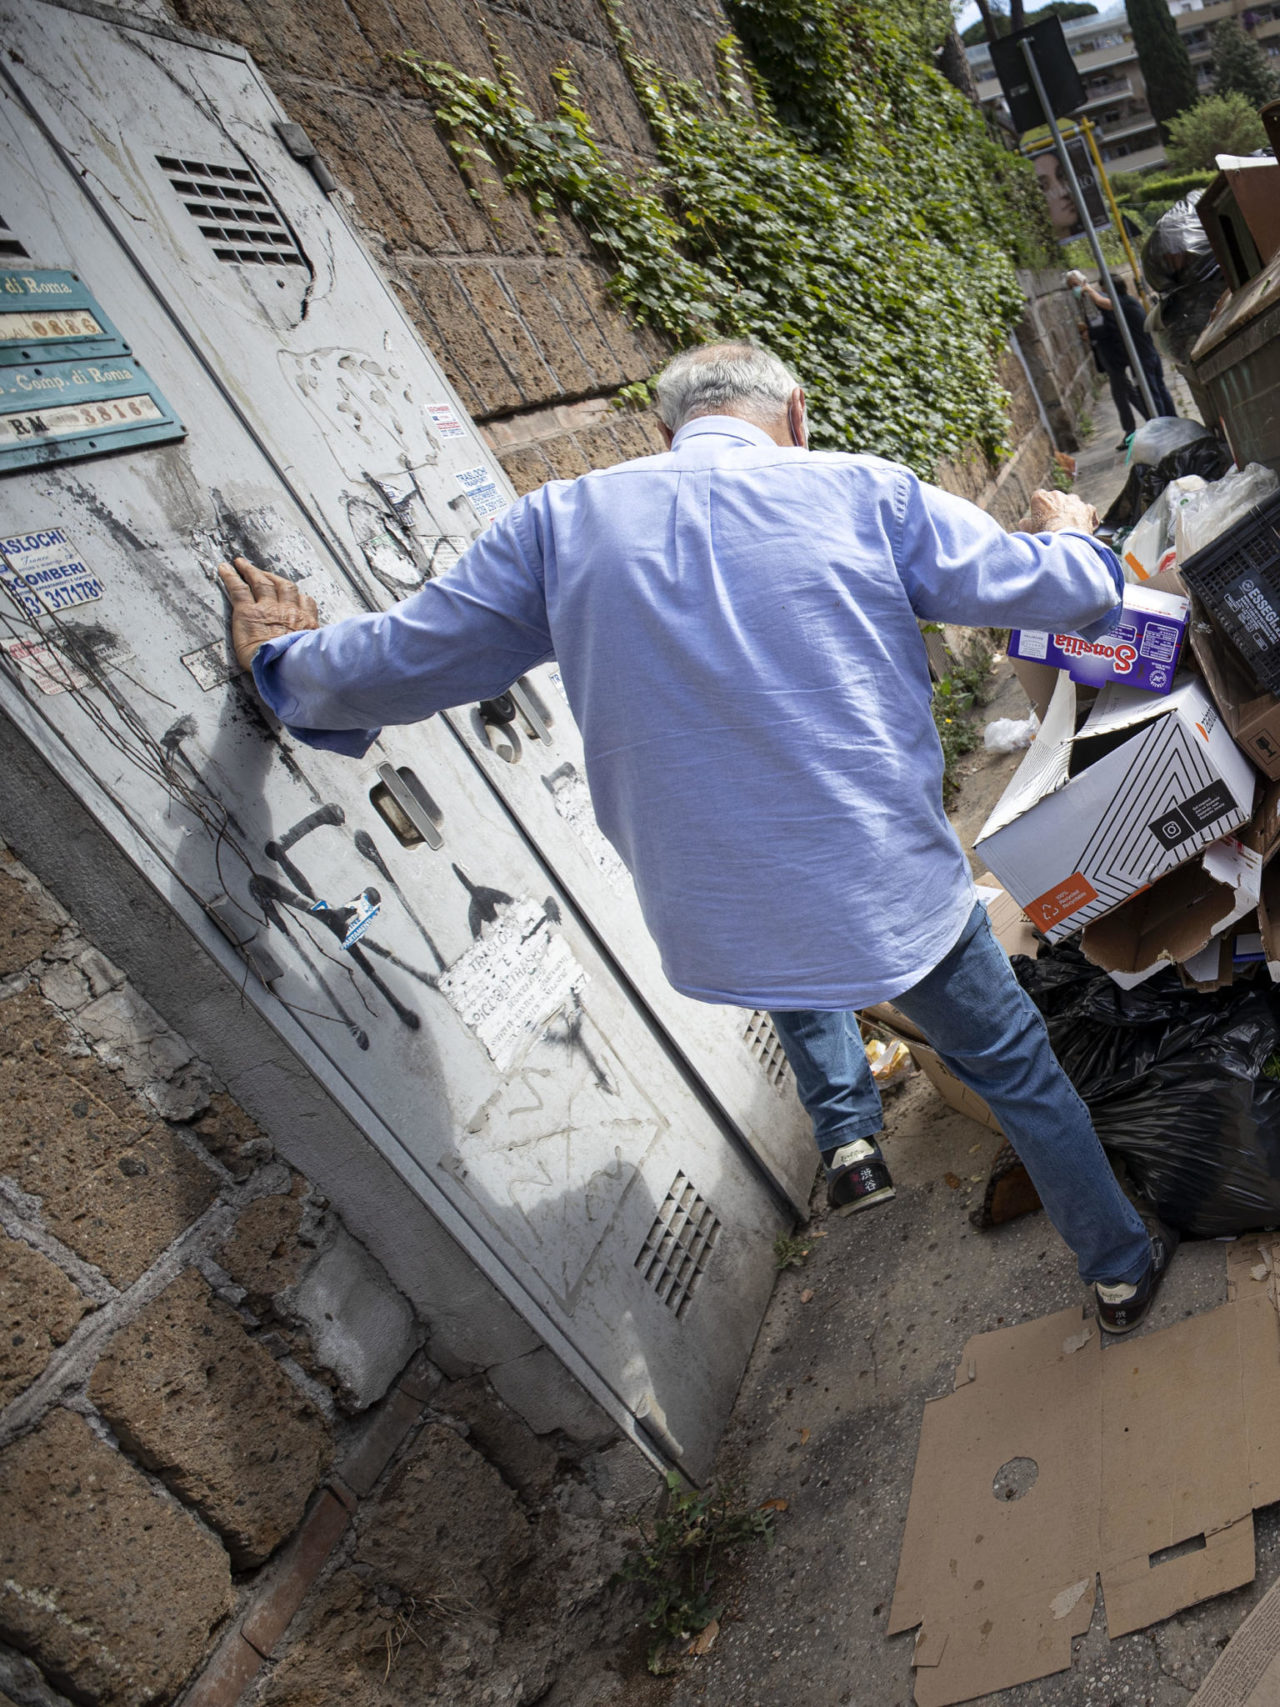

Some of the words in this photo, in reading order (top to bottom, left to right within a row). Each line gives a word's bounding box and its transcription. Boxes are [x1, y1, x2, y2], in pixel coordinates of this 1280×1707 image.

[5, 277, 23, 293] di
[22, 277, 73, 294] Roma
[16, 374, 70, 393] Comp.
[72, 370, 89, 385] di
[88, 368, 134, 384] Roma
[8, 415, 50, 436] RM
[80, 402, 142, 424] 3816
[45, 579, 105, 609] 3171781
[1248, 588, 1279, 627] ESSEGI
[1055, 634, 1137, 672] Sonsilia
[860, 1168, 876, 1191] 渋谷
